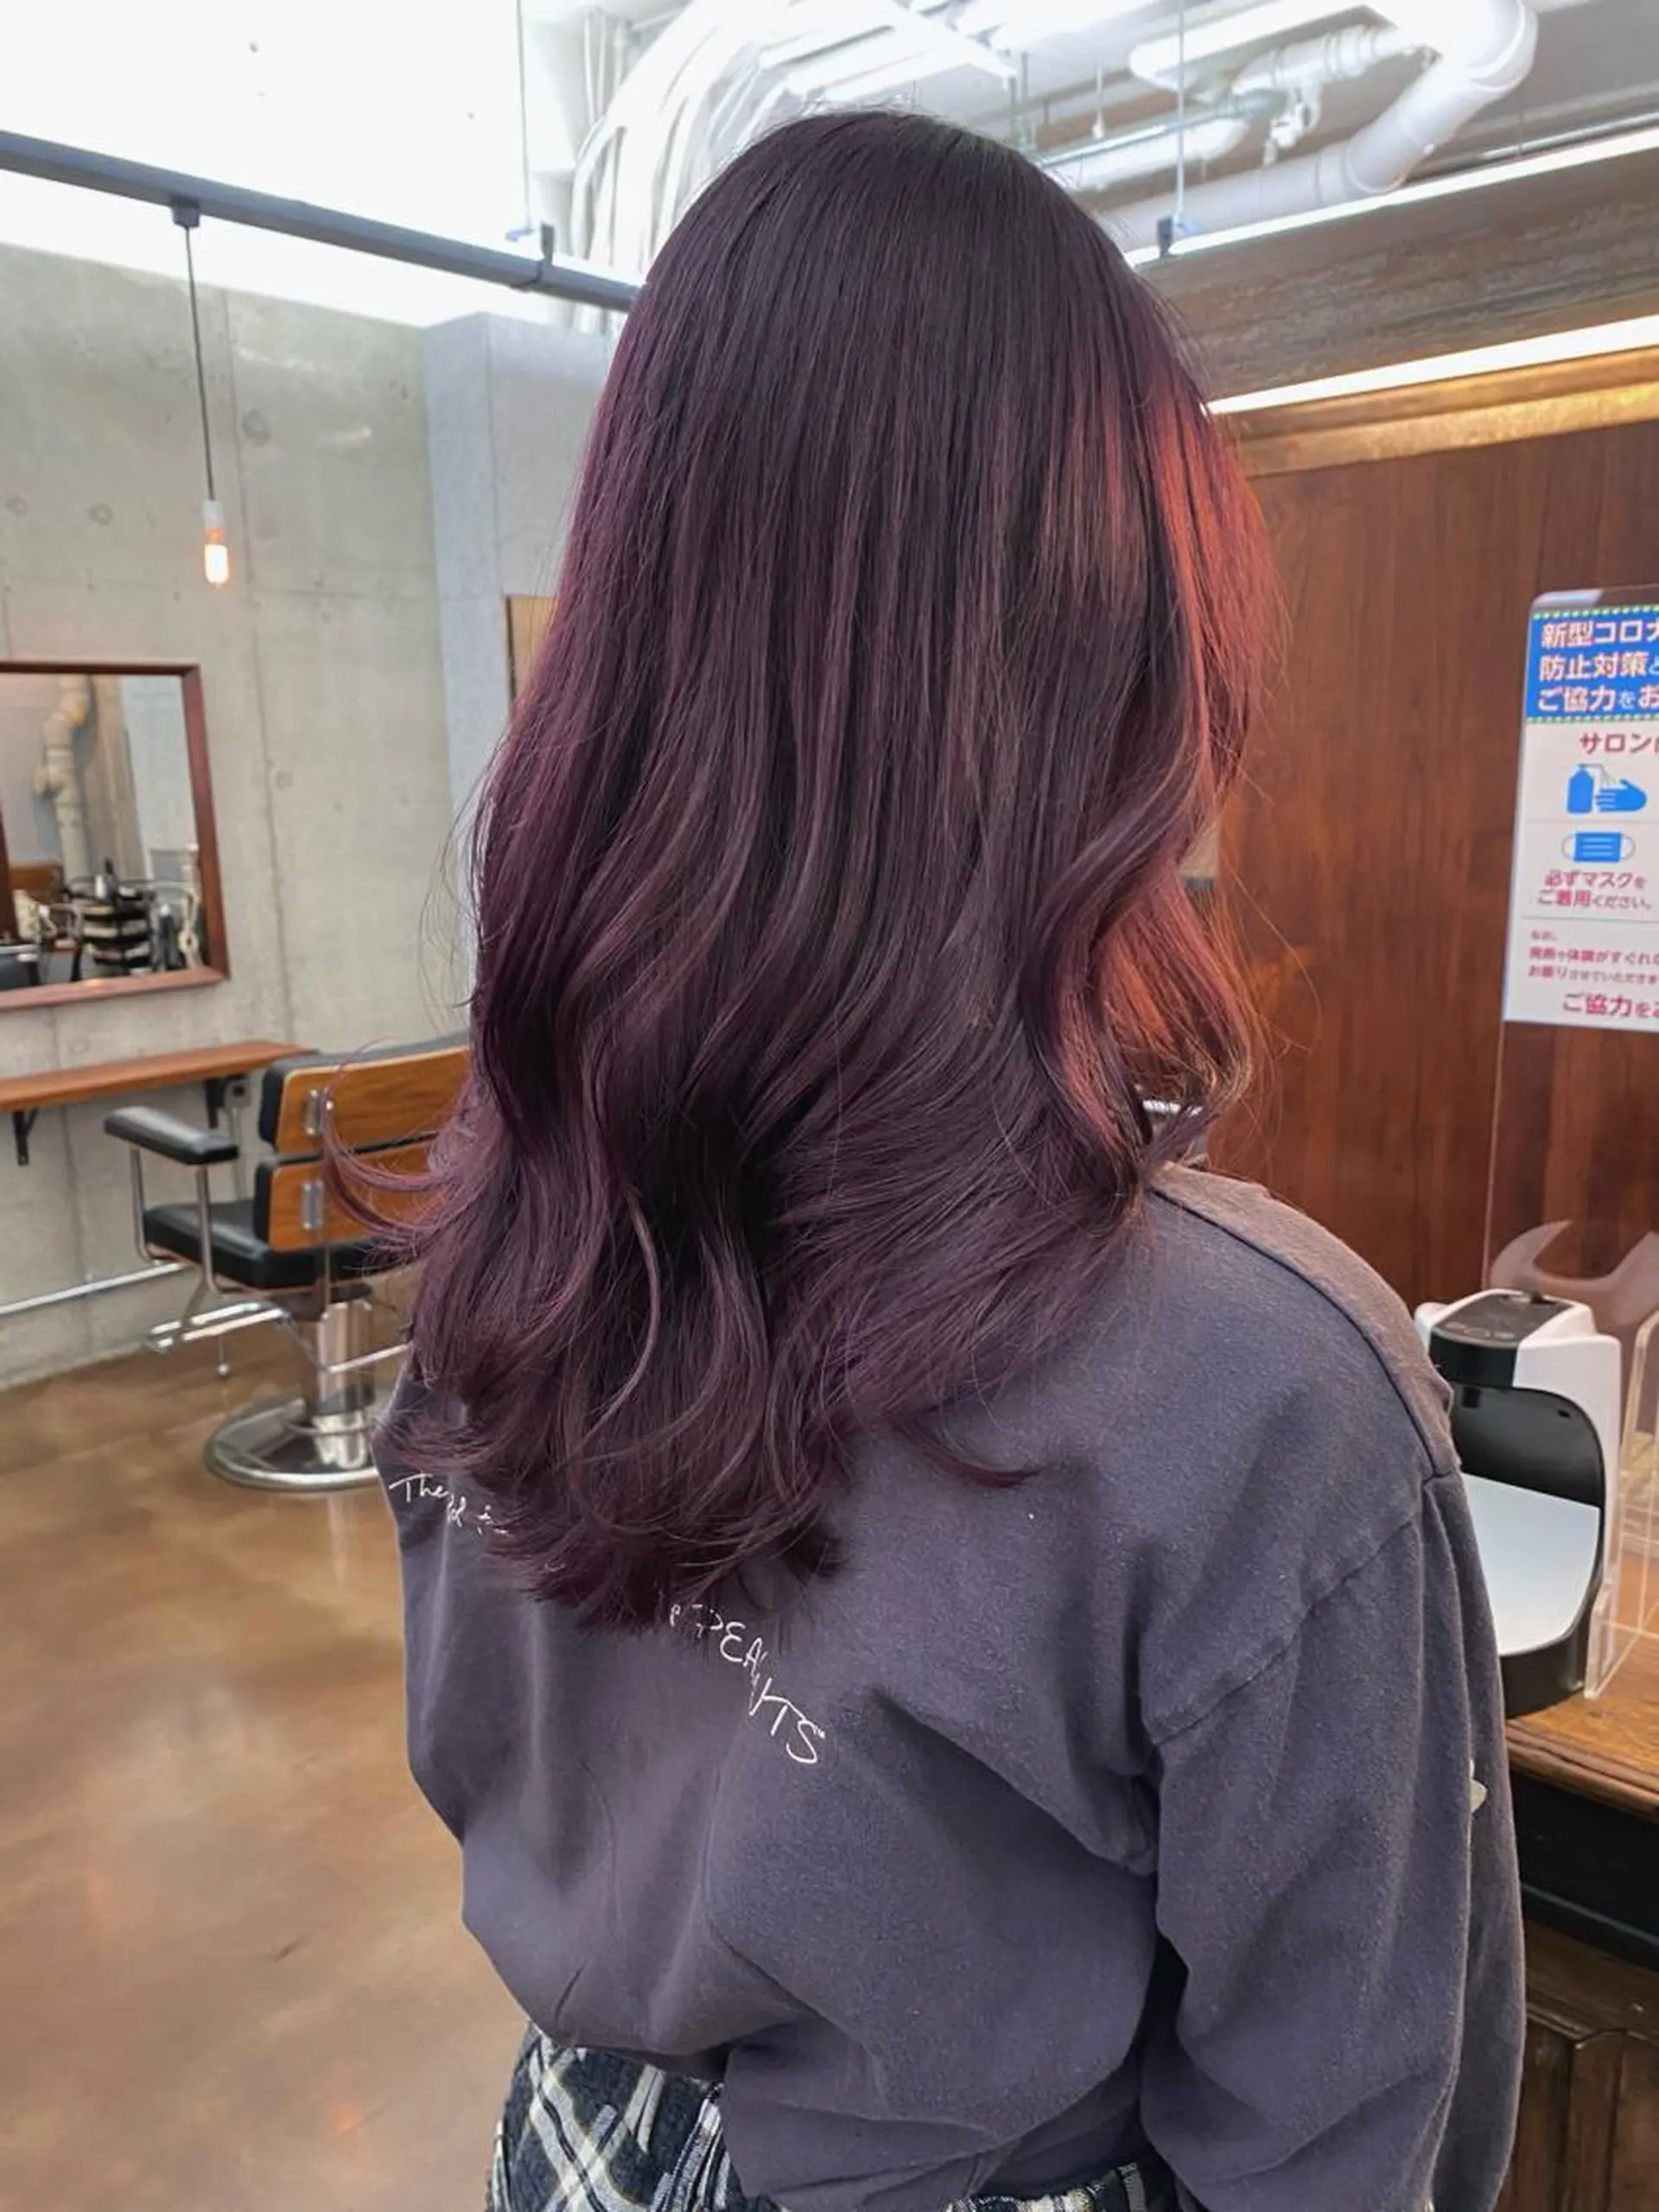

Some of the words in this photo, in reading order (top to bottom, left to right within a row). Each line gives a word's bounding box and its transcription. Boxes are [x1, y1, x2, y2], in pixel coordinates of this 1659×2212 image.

[1537, 684, 1659, 712] ご協力をお
[1580, 732, 1659, 754] サロン
[389, 1471, 450, 1503] The
